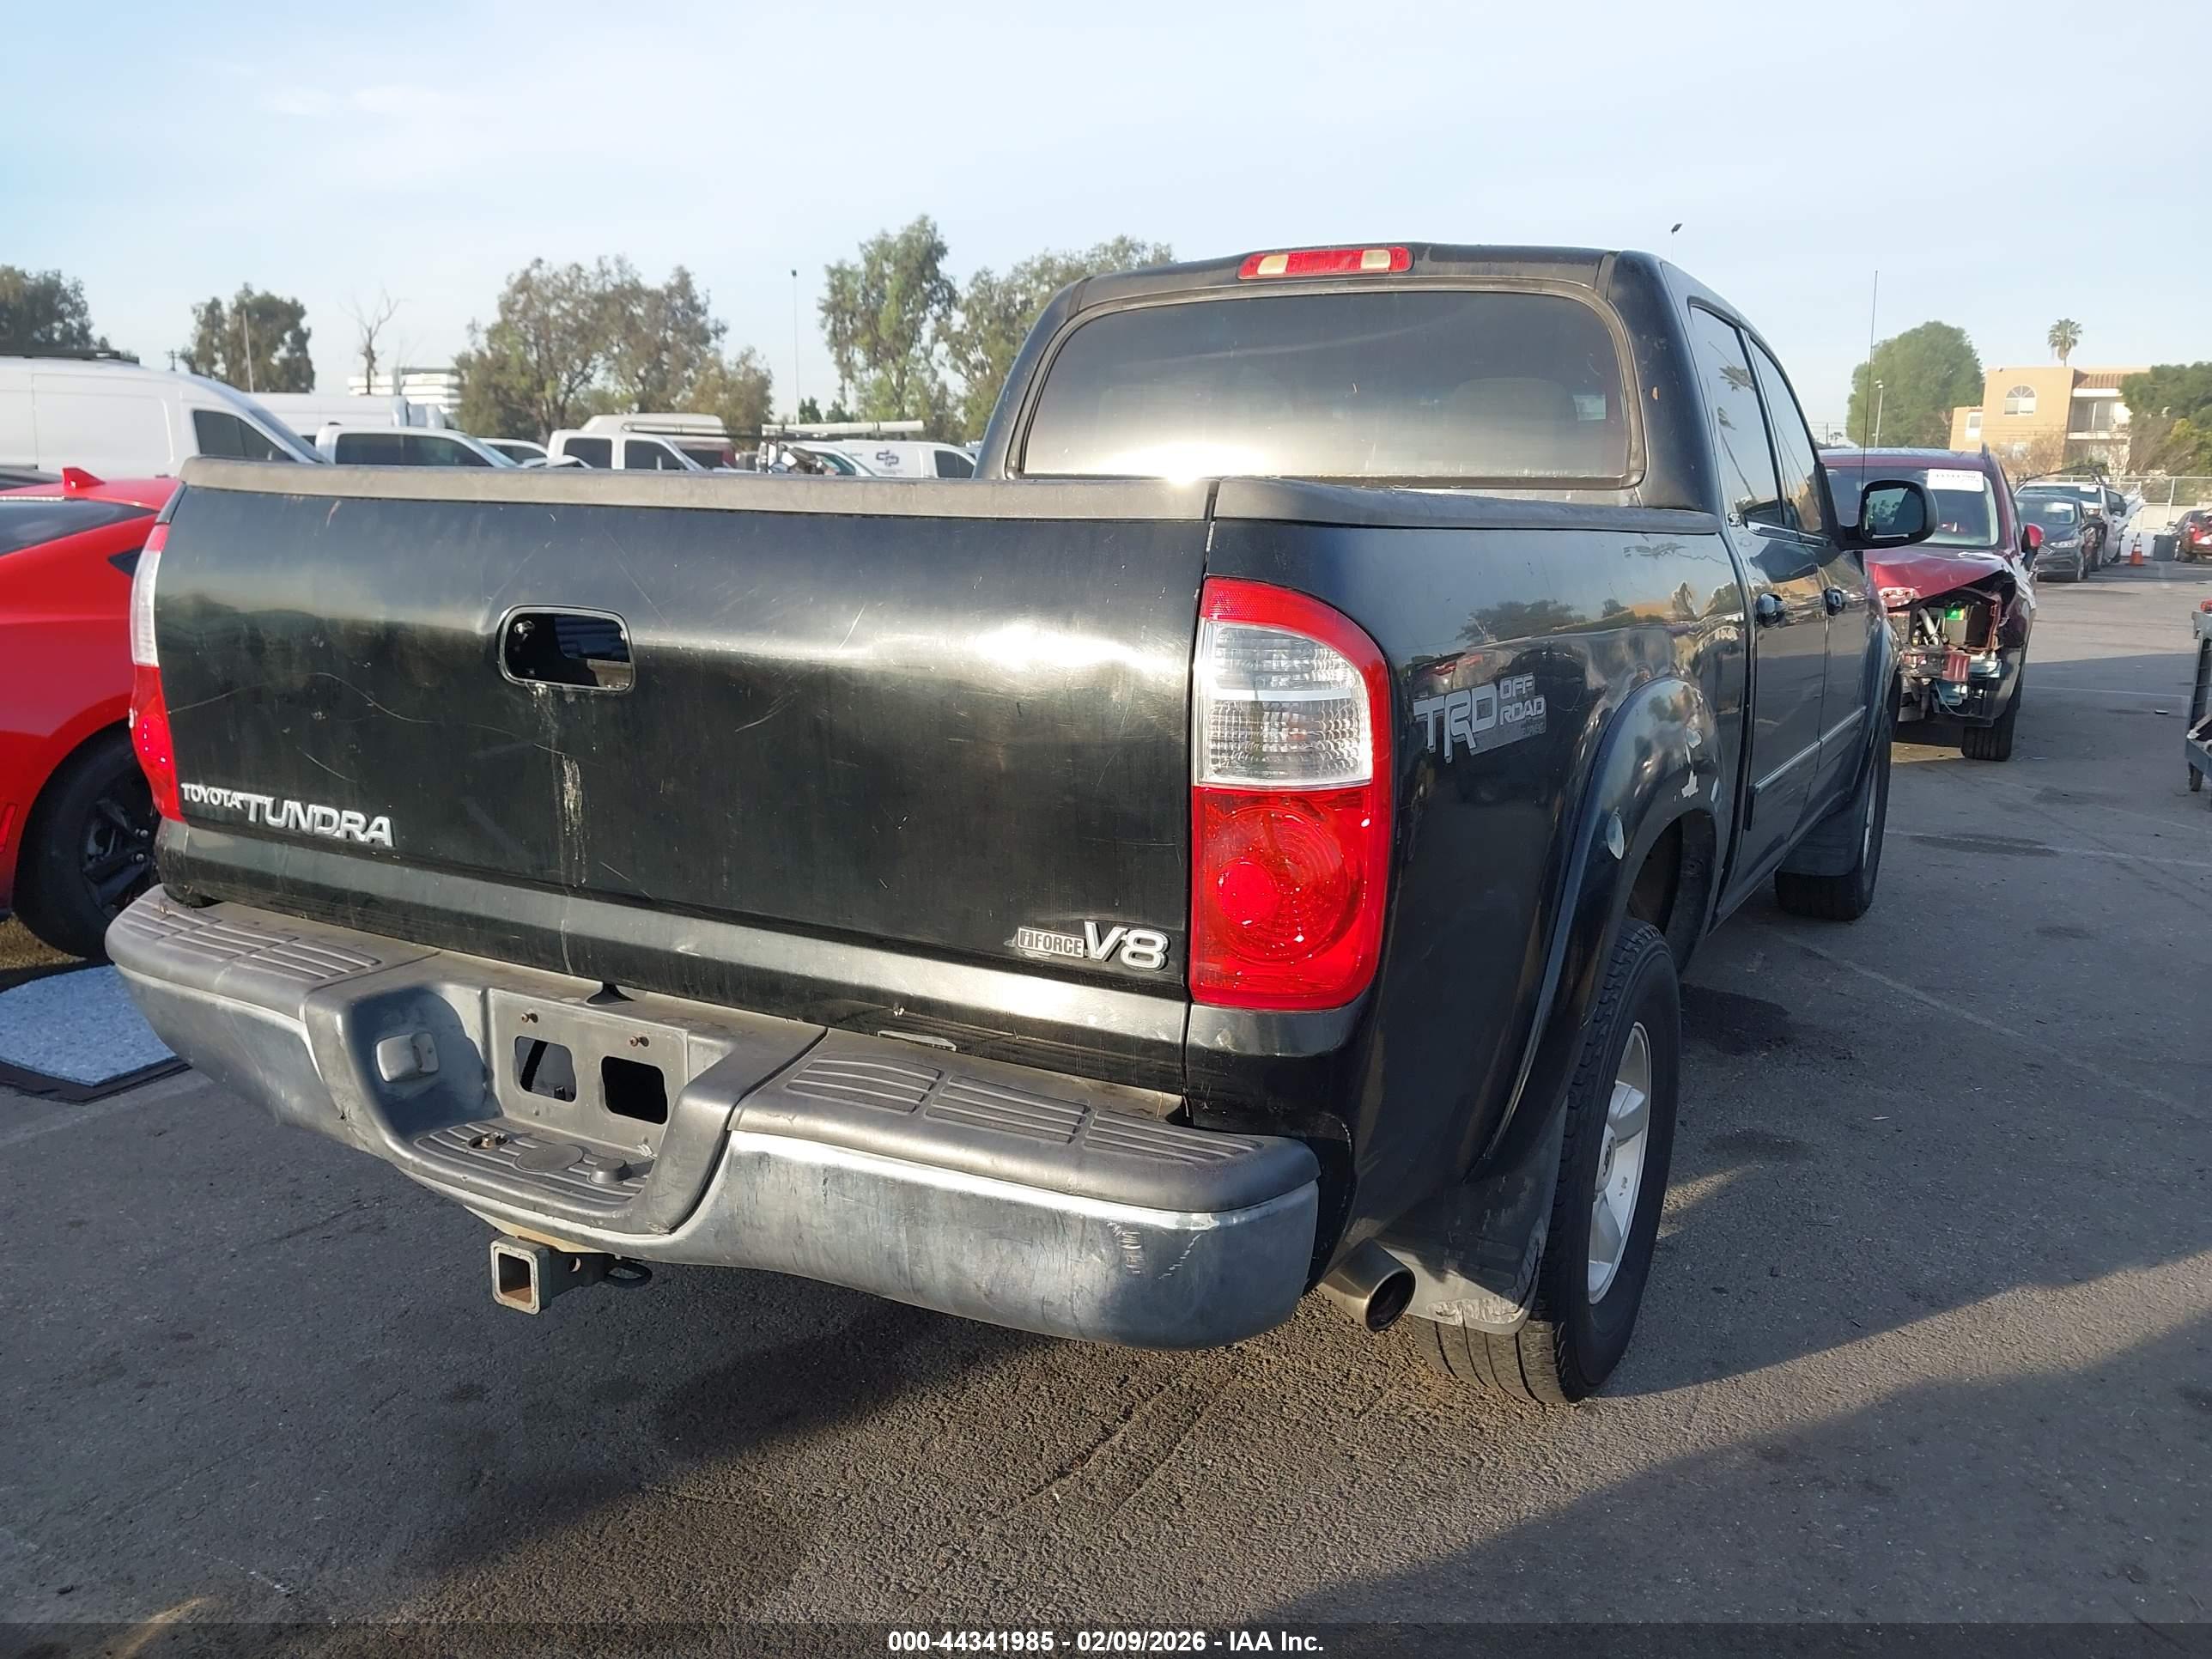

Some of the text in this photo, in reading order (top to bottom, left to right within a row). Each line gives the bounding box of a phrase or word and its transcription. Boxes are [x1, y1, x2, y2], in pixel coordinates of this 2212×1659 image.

[1499, 672, 1534, 700] OFF
[1499, 696, 1546, 726] ROAD
[1413, 683, 1498, 759] TRD
[180, 782, 393, 848] TOYOTA TUNDRA
[1085, 921, 1169, 971] V8
